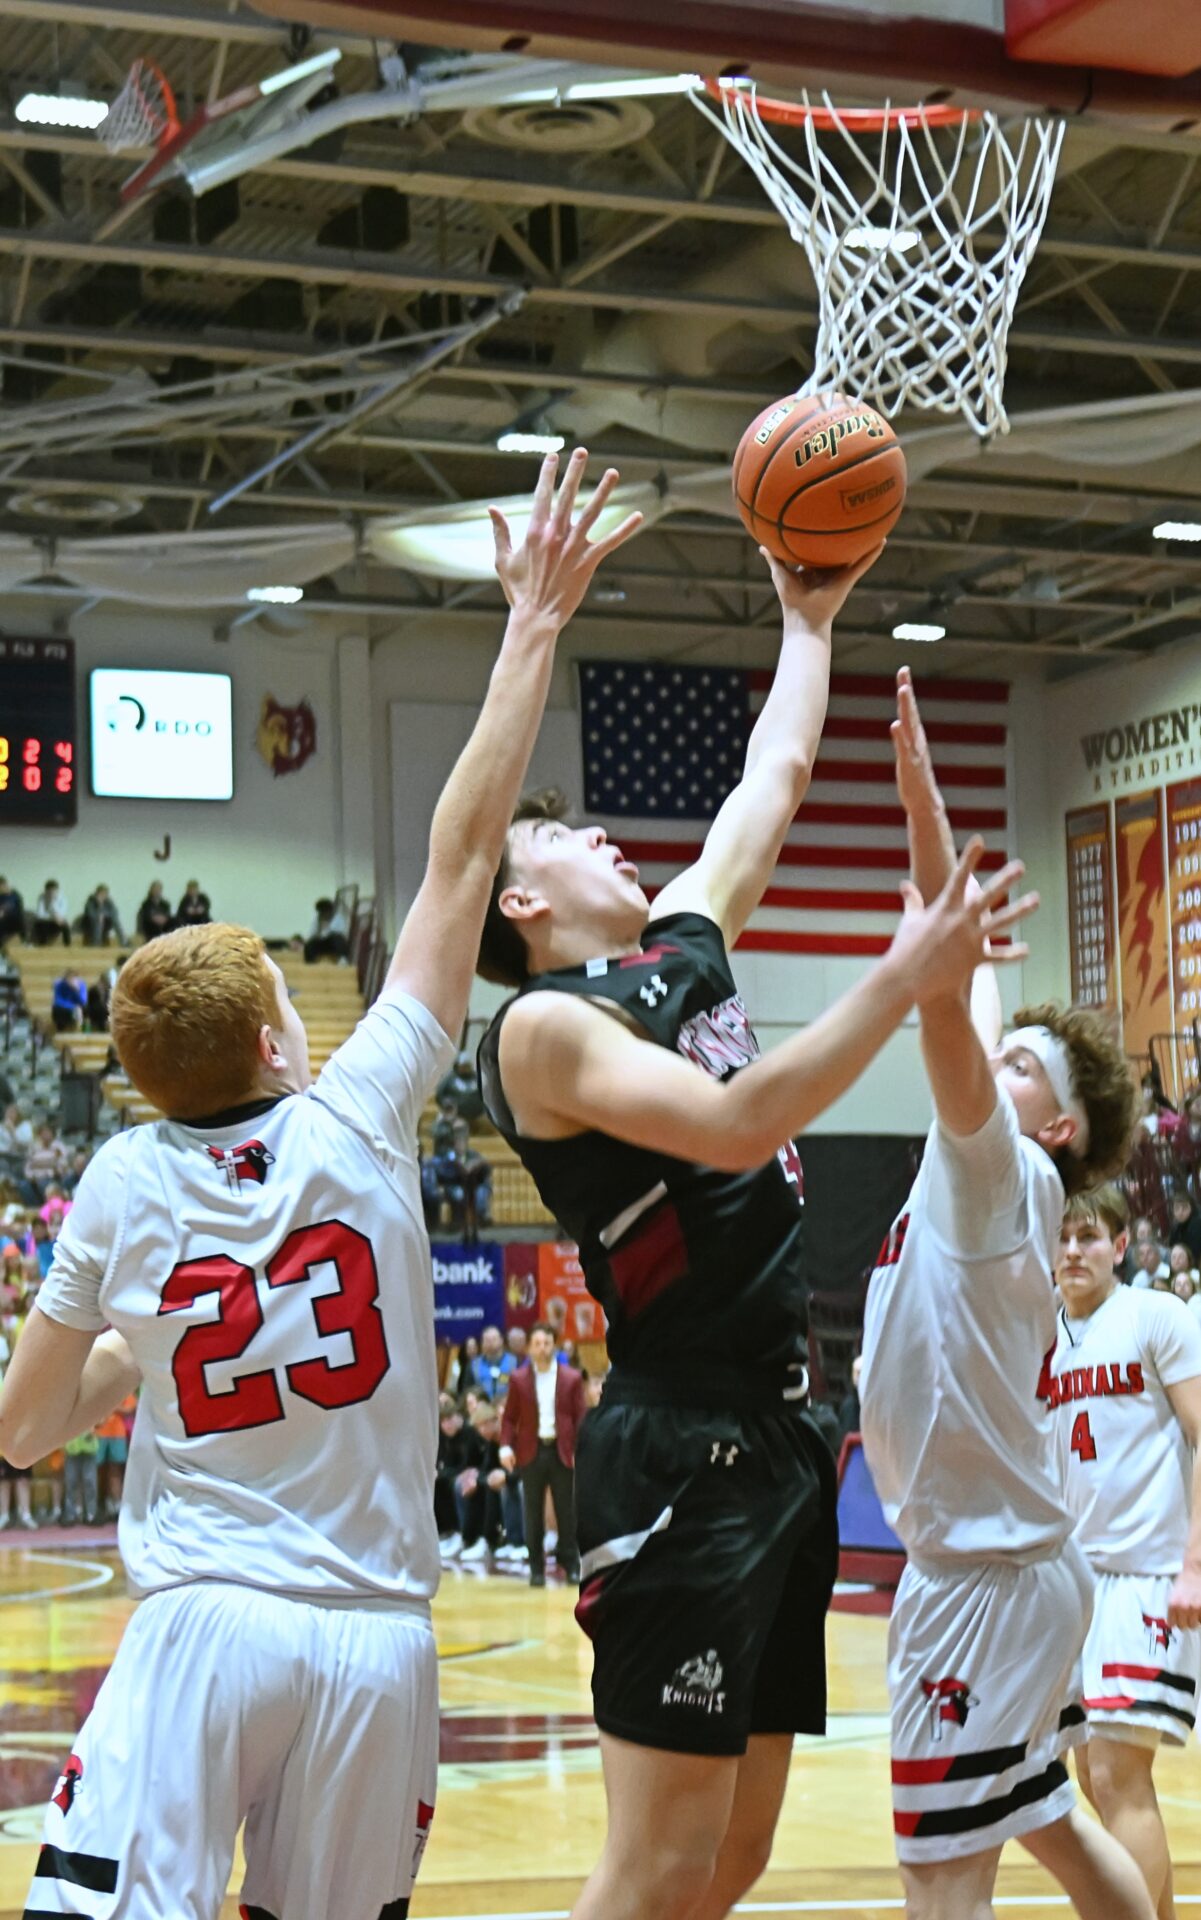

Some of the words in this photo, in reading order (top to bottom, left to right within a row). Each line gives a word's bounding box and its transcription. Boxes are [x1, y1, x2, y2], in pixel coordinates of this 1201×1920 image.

[794, 411, 885, 469] Baden
[1080, 703, 1201, 772] WOMEN'
[153, 833, 172, 861] J
[432, 1256, 494, 1284] bank
[157, 1219, 391, 1438] 23
[1045, 1361, 1145, 1412] RDINALS
[1070, 1410, 1097, 1463] 4
